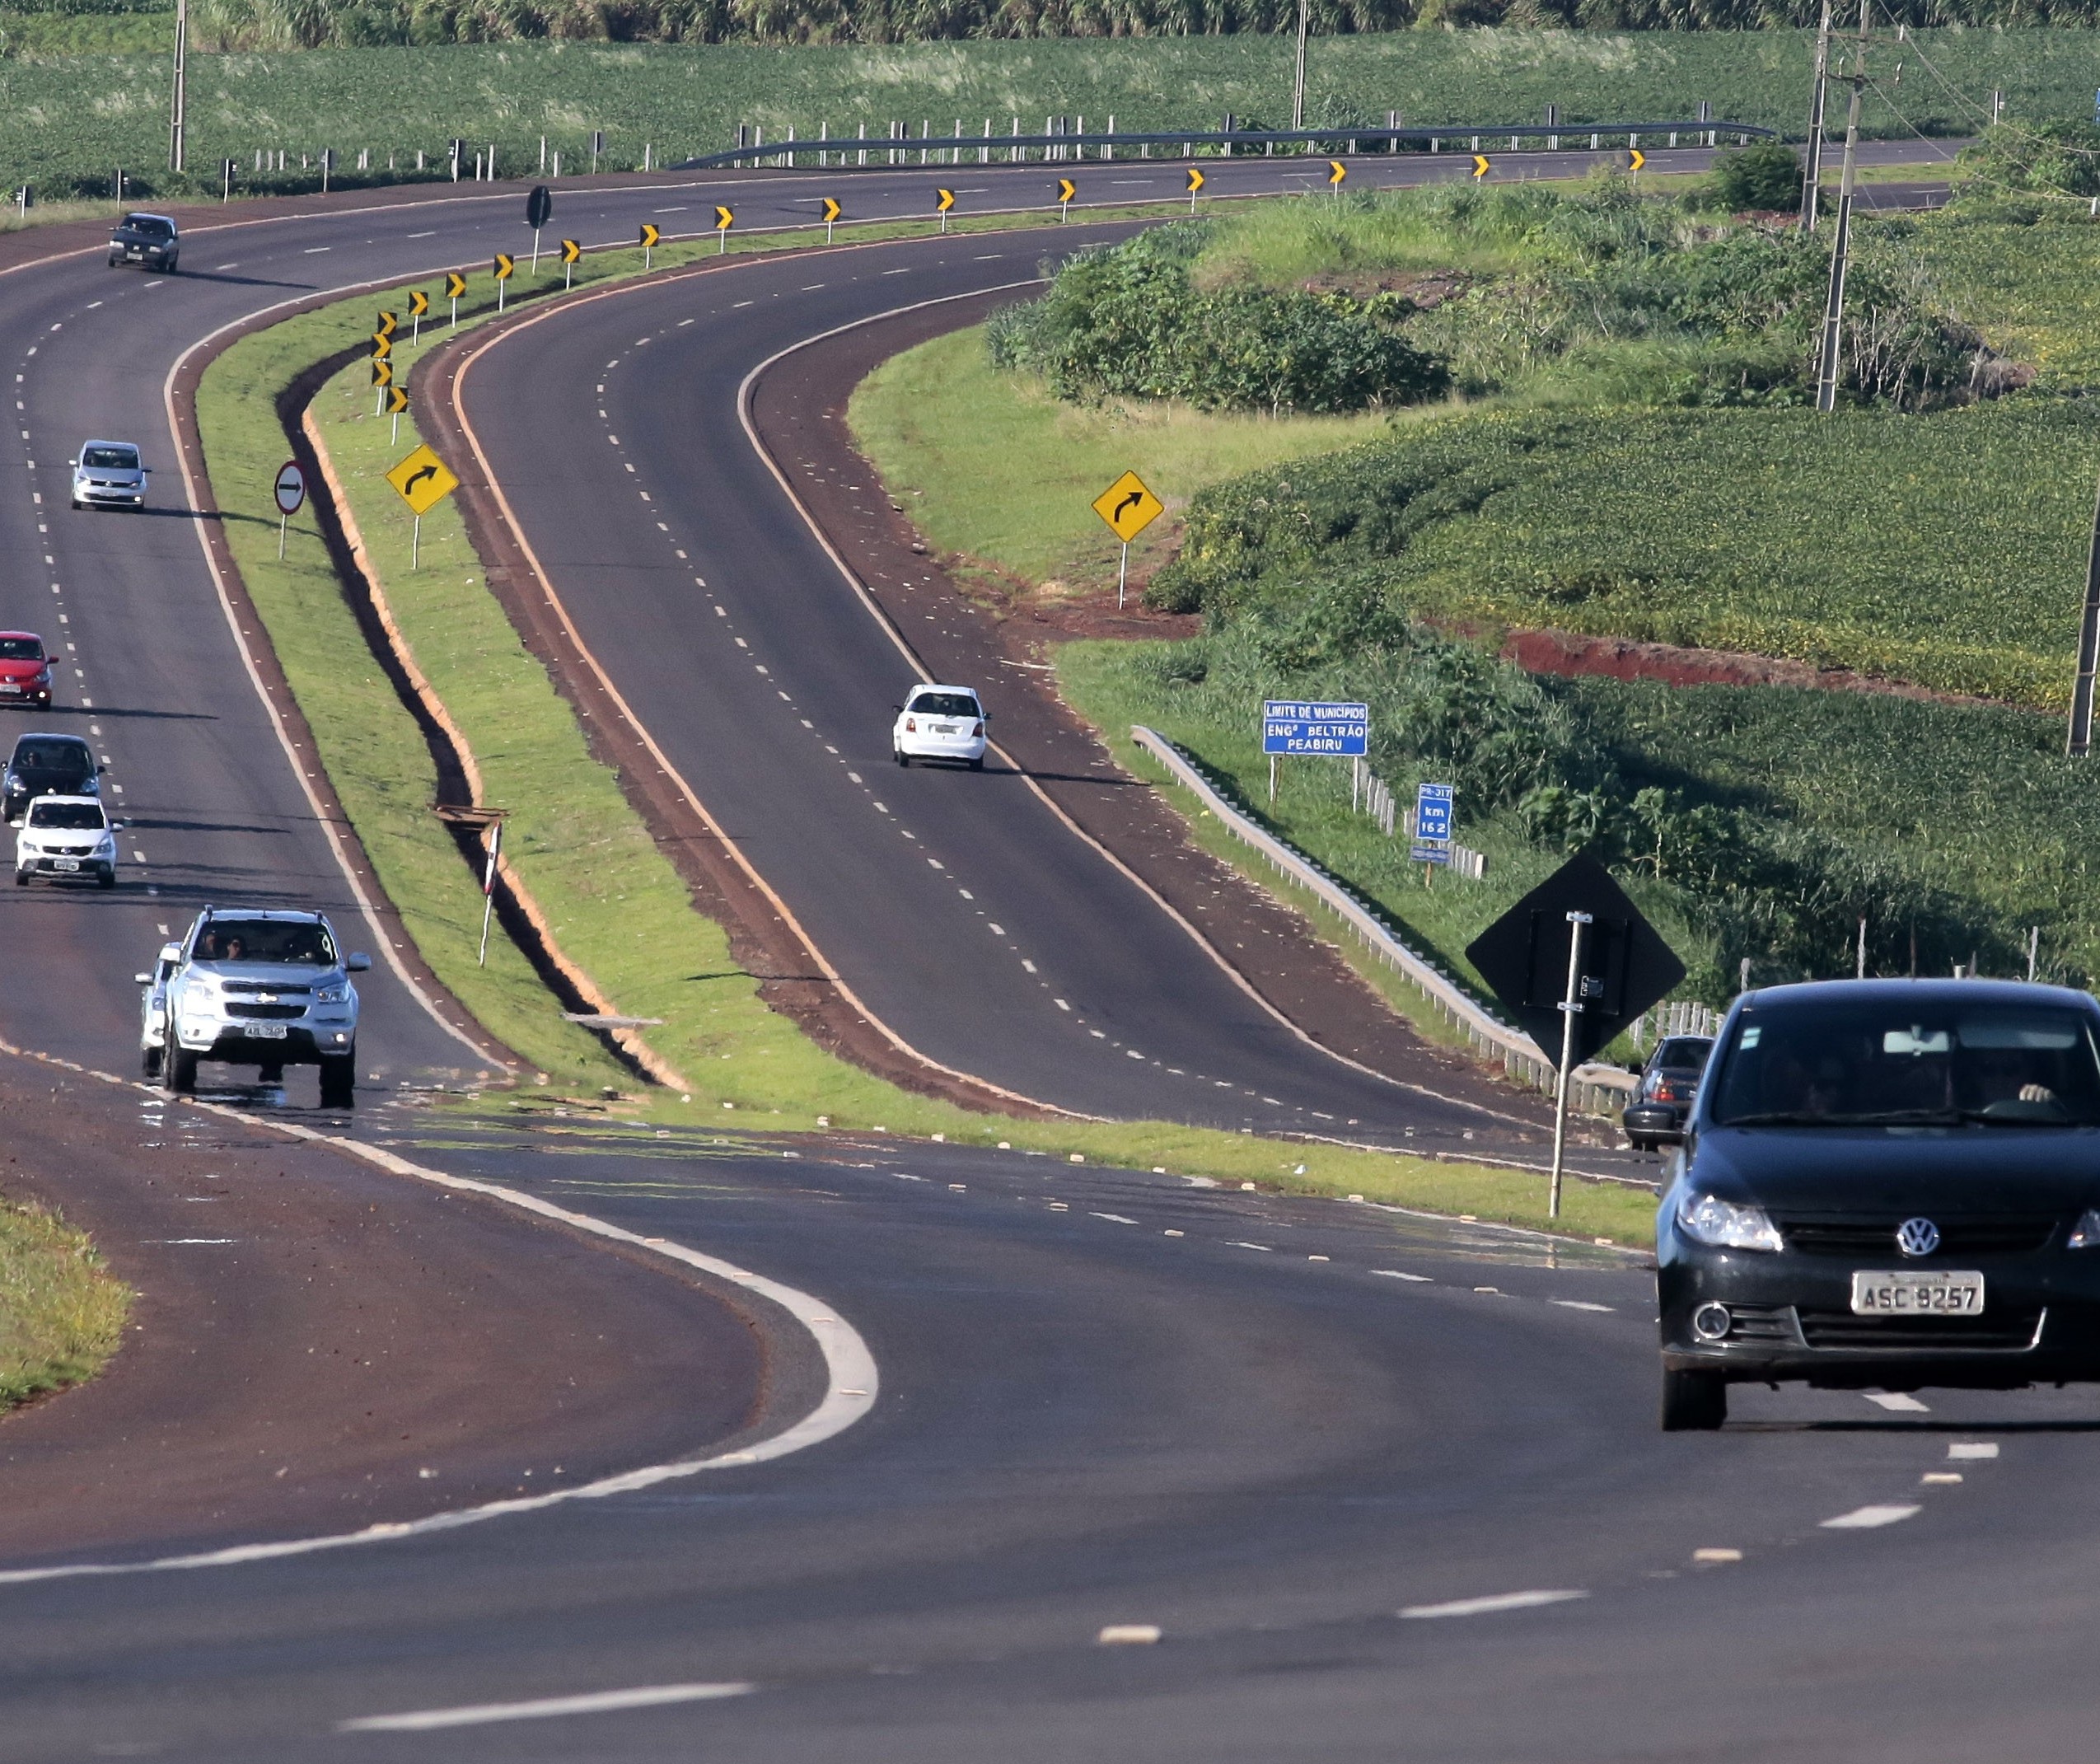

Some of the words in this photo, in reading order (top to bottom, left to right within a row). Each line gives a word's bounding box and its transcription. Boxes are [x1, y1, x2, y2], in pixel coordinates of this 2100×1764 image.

[1266, 704, 1296, 718] LIMITE
[1298, 705, 1312, 719] DE
[1307, 724, 1364, 737] BELTRÃO
[1288, 738, 1343, 751] PEABIRU
[1420, 786, 1451, 798] PR-317
[1424, 806, 1445, 818] km
[1421, 821, 1446, 834] 162
[1864, 1287, 1907, 1308] ASC
[1915, 1286, 1977, 1309] 9257
